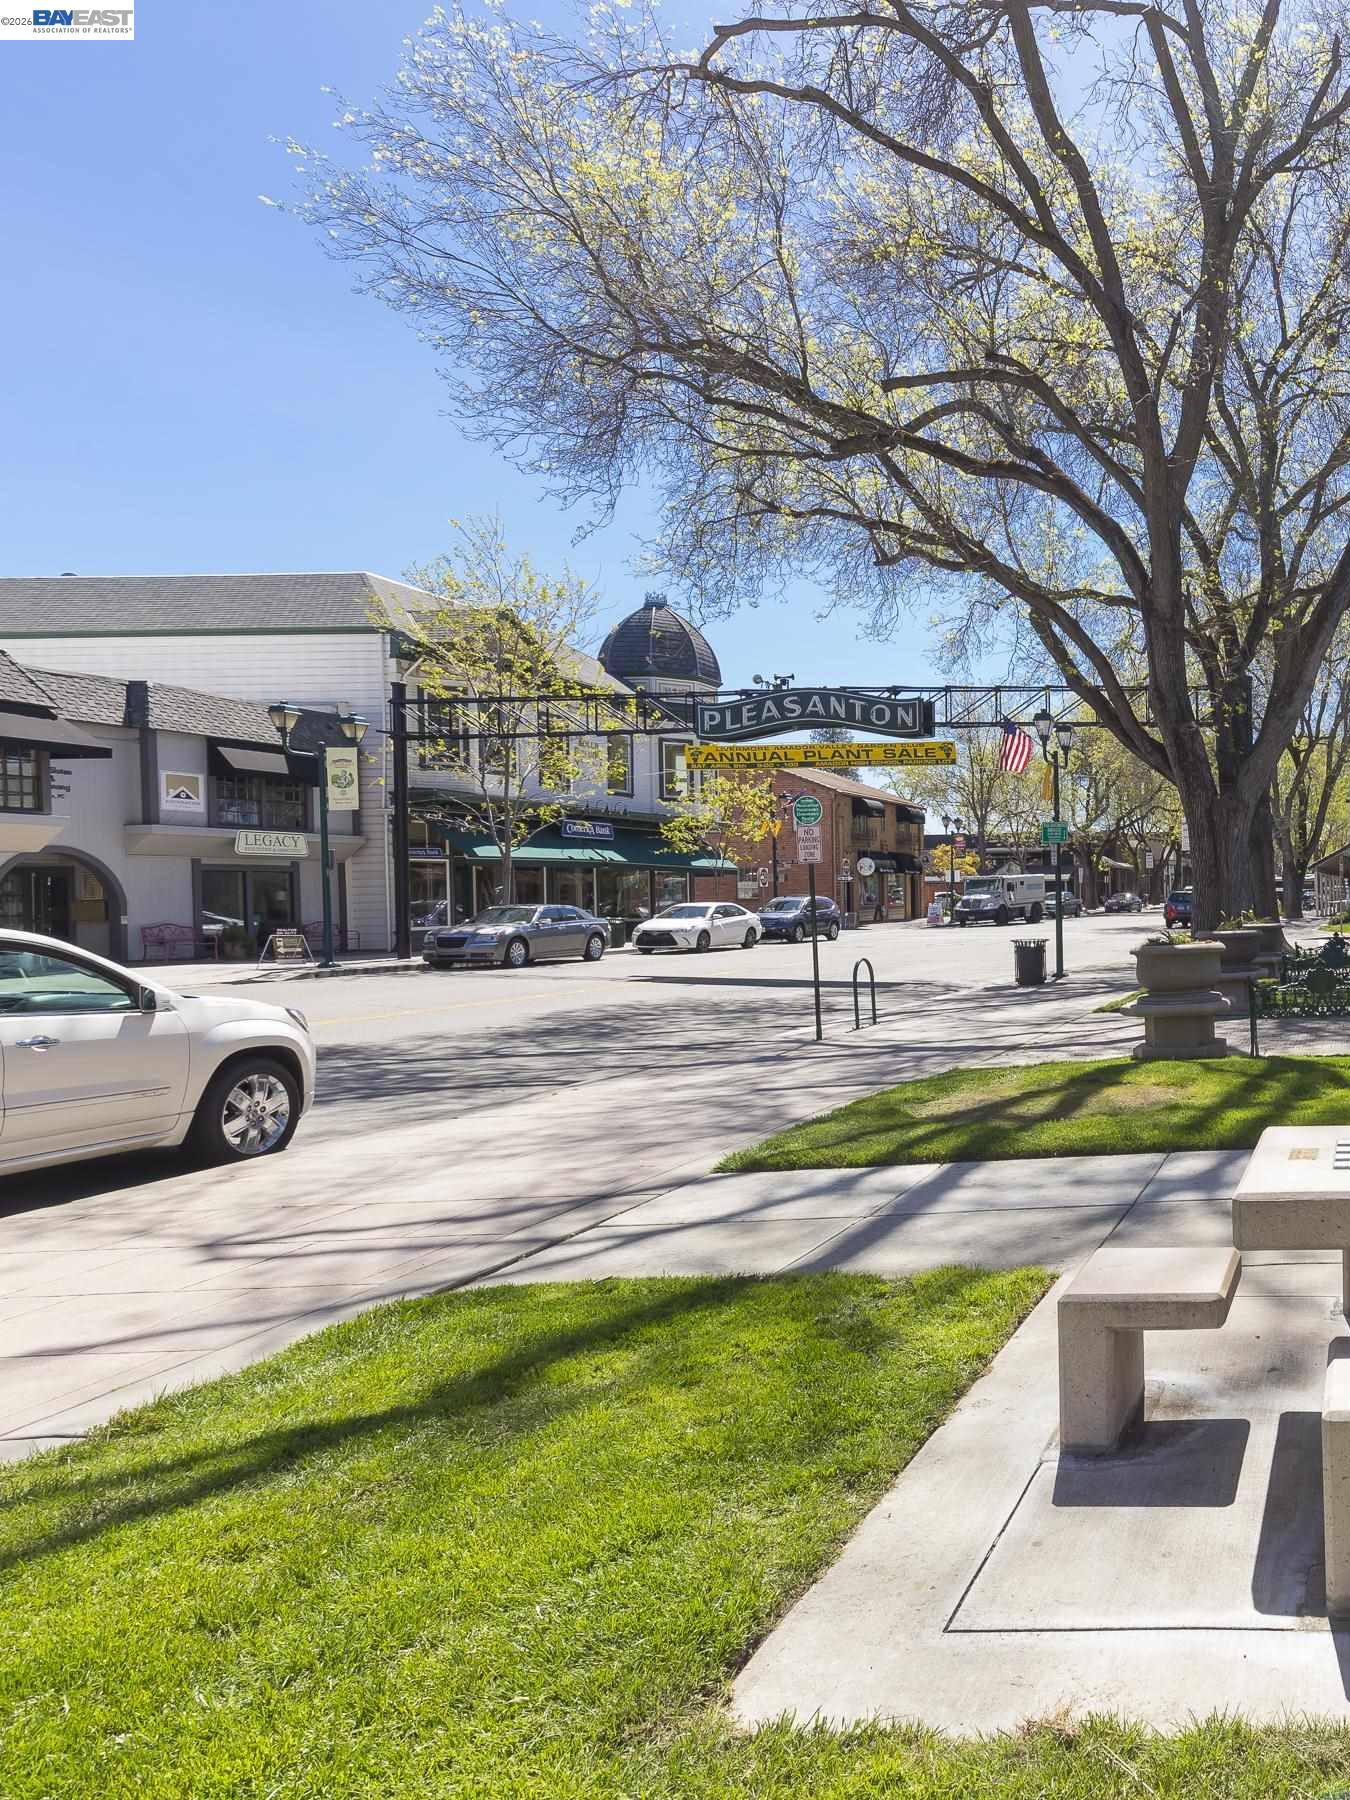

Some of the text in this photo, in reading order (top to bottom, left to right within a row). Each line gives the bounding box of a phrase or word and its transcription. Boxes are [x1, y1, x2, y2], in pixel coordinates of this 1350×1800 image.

[704, 695, 912, 731] PLEASANTON
[704, 747, 936, 762] ANNUAL PLANT SALE
[245, 834, 300, 848] LEGACY
